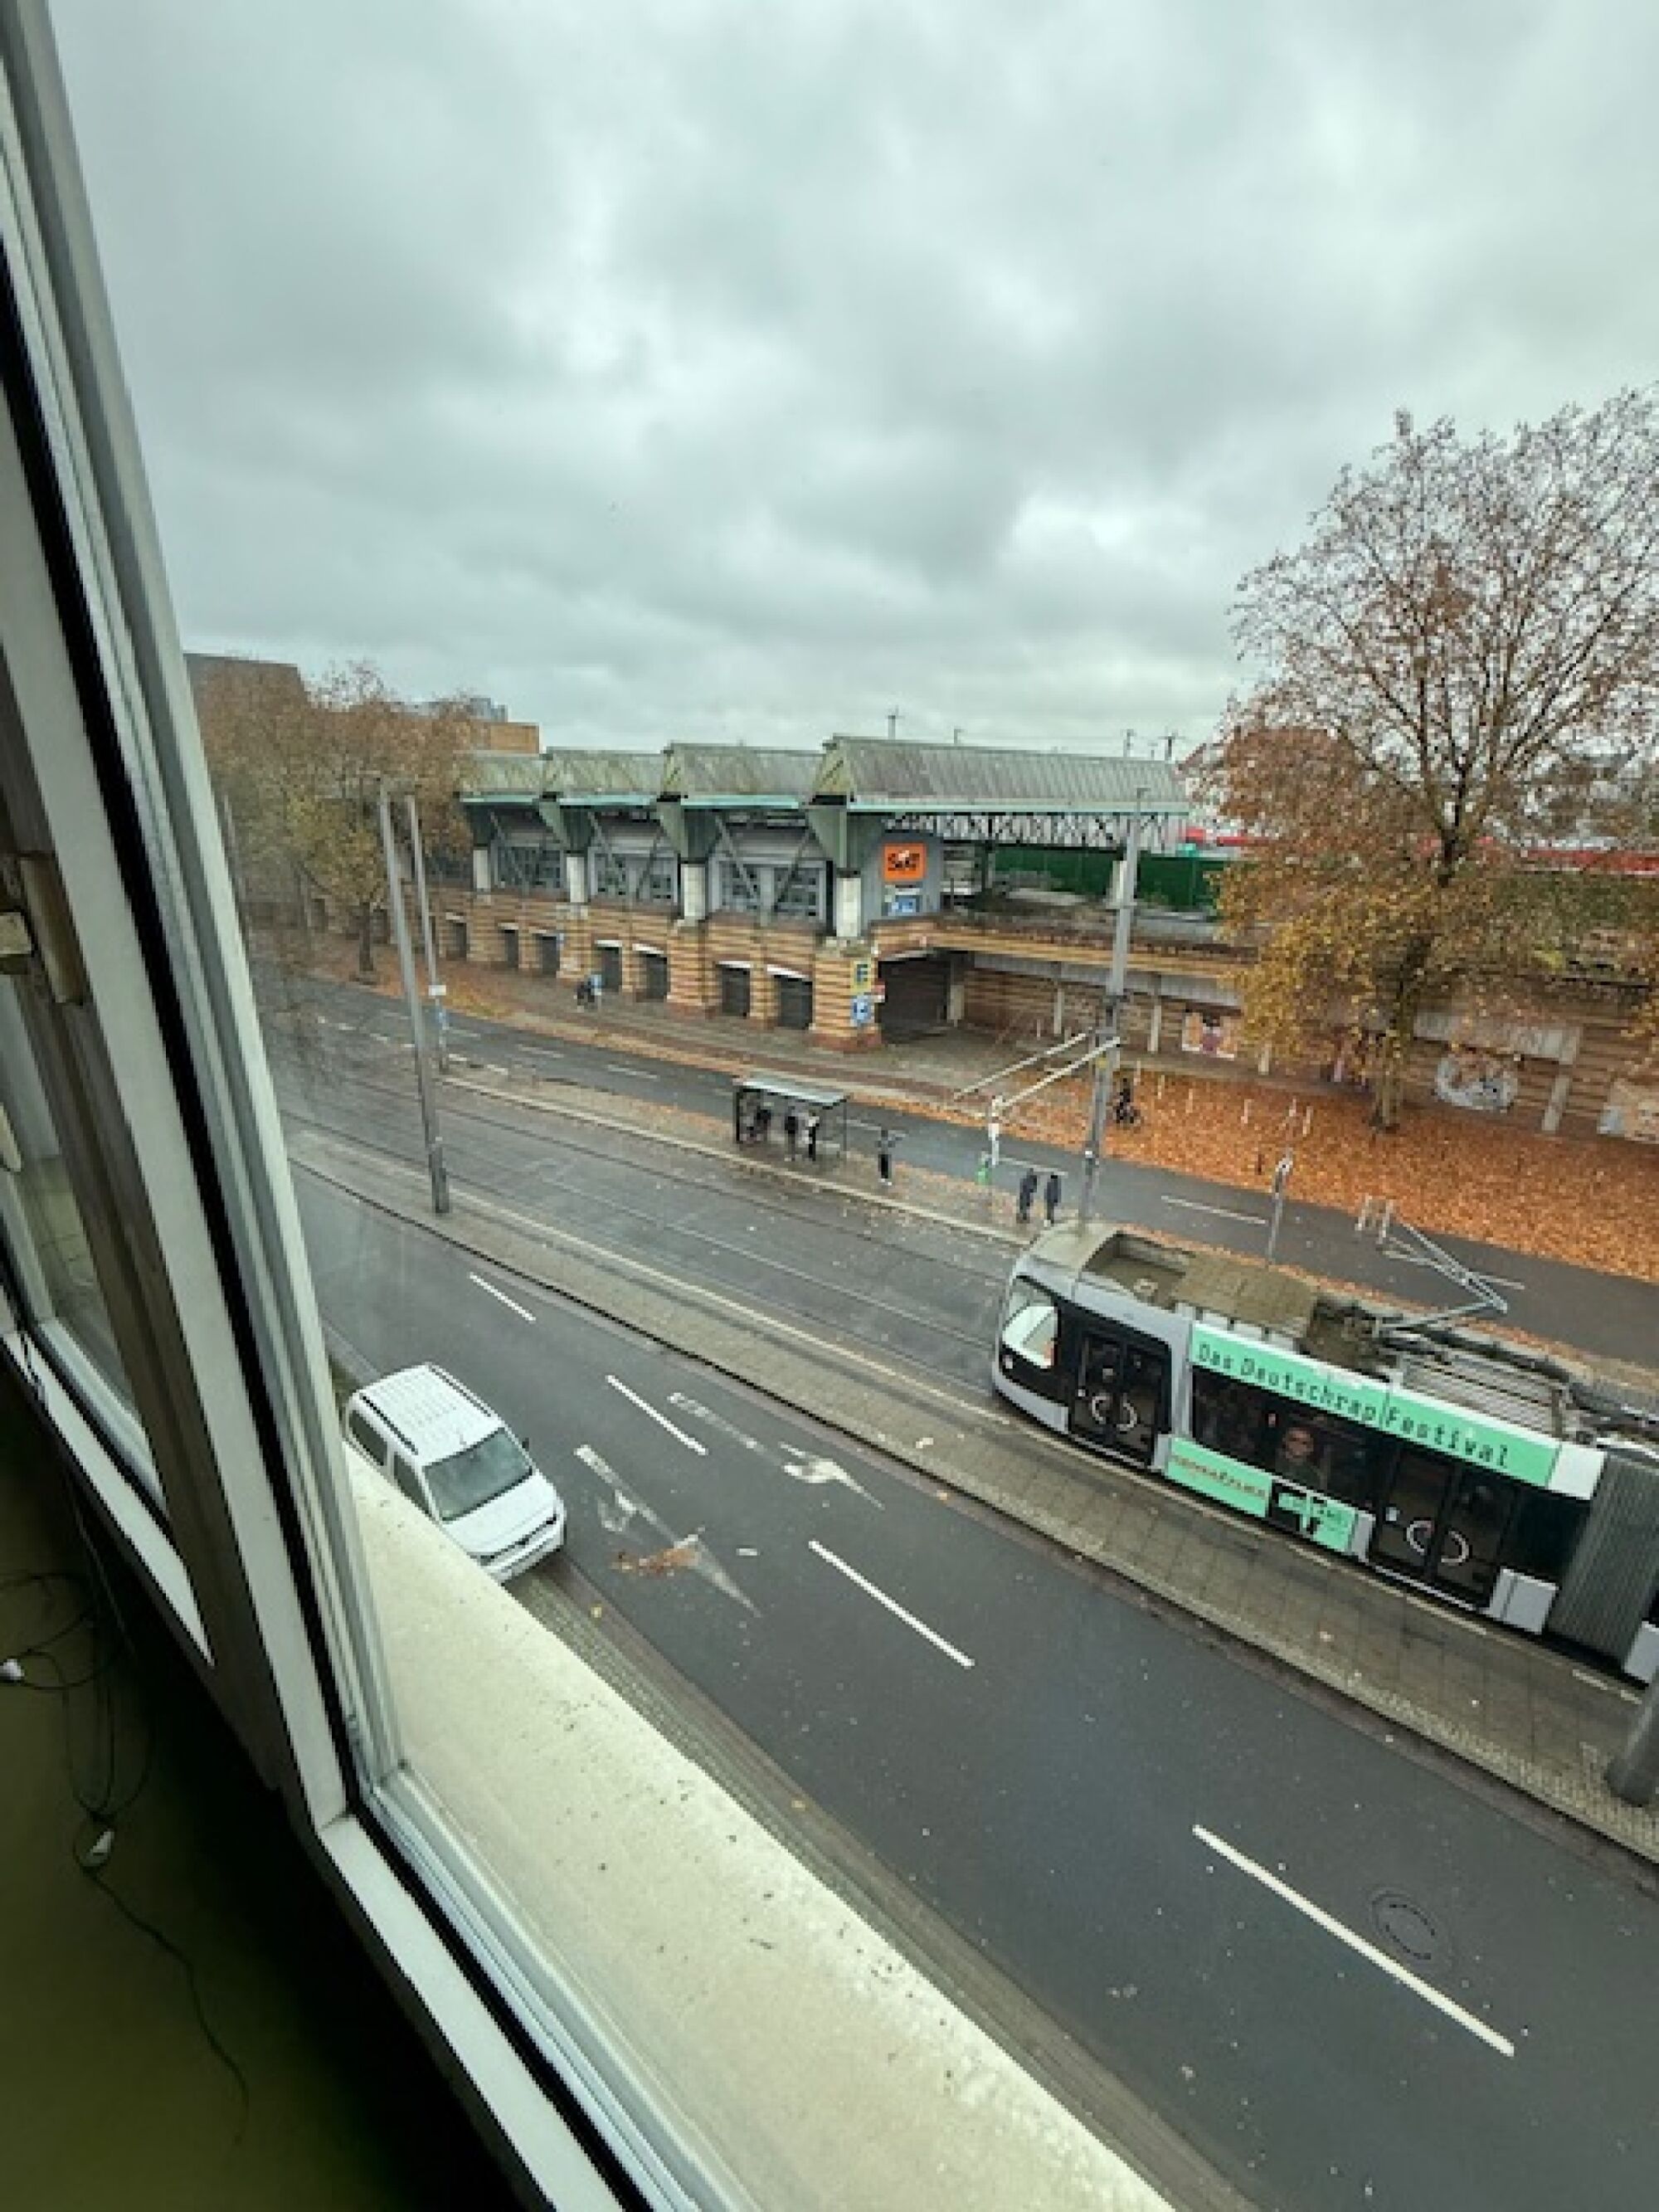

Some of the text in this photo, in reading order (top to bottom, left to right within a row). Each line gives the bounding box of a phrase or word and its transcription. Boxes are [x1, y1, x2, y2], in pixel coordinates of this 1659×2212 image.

[1198, 1342, 1509, 1468] Das Deutschrap Festival
